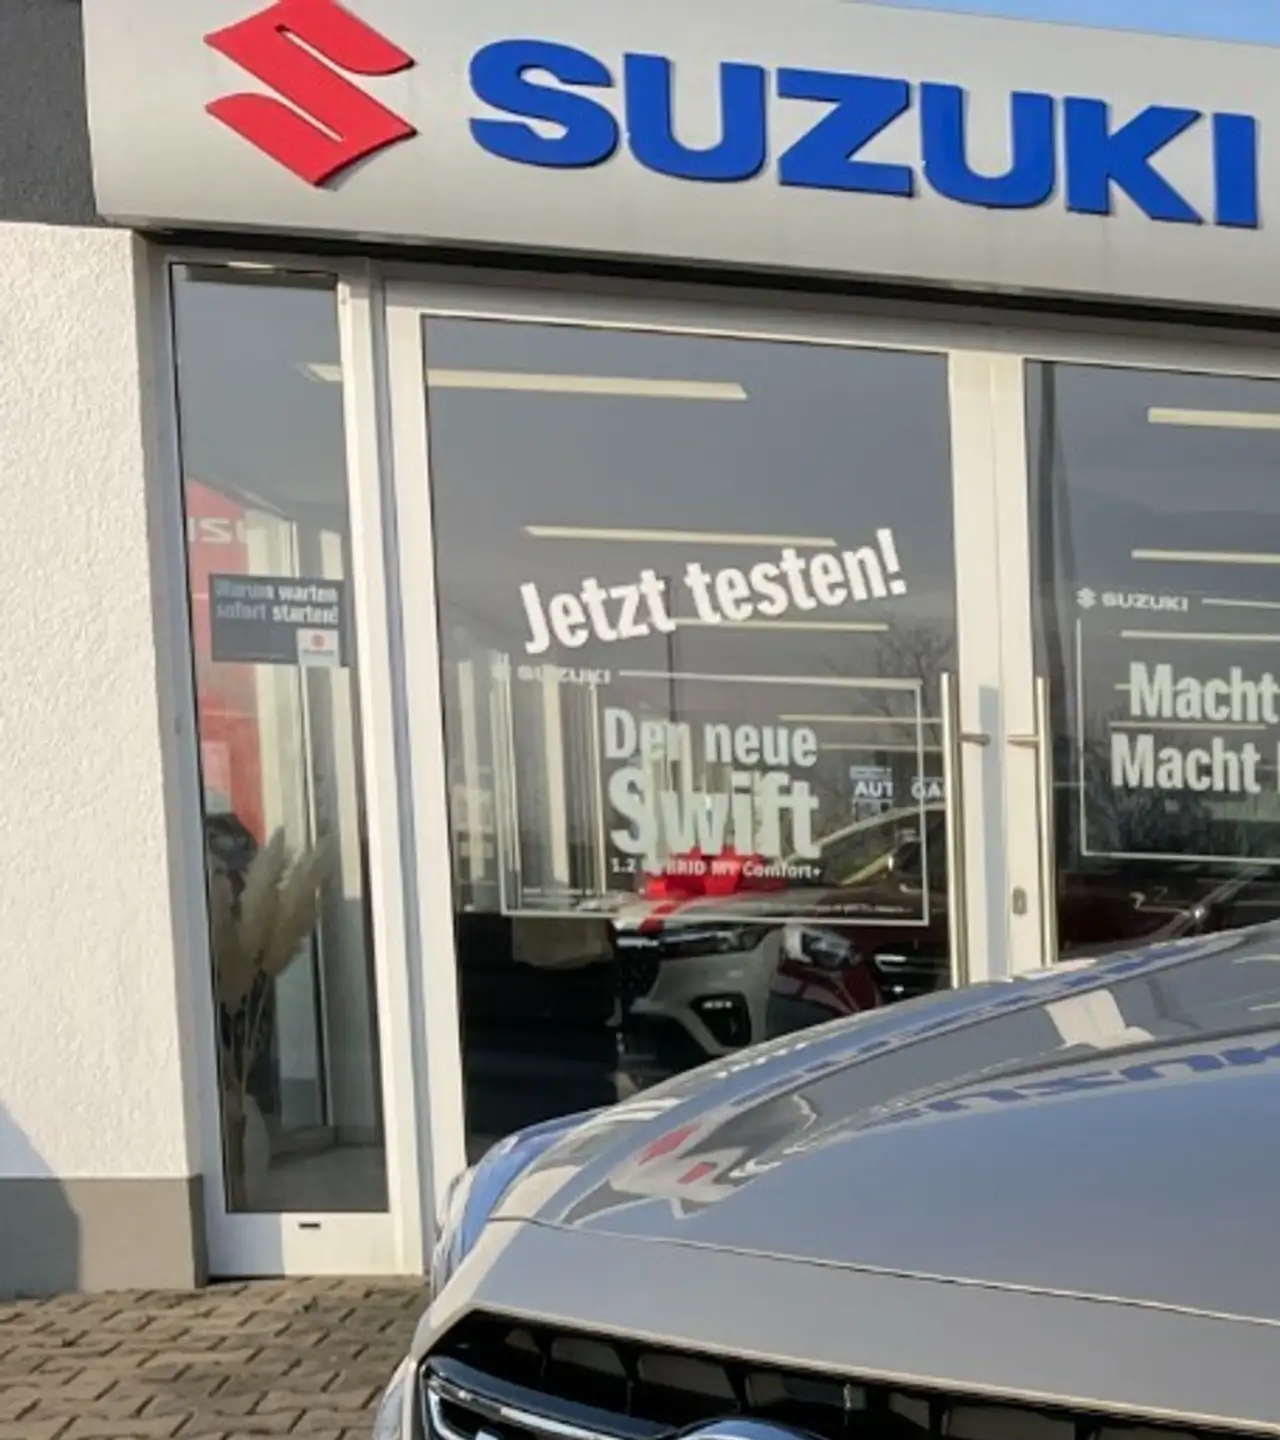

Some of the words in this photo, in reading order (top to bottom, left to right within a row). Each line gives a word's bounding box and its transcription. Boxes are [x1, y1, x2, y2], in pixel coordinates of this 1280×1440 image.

[467, 40, 1257, 228] SUZUKI
[519, 576, 676, 656] Jetzt
[683, 528, 907, 622] testen!
[1101, 590, 1189, 612] SUZUKI
[1129, 662, 1279, 725] Macht
[704, 721, 818, 767] neue
[1110, 733, 1262, 795] Macht
[608, 766, 821, 860] Swift
[611, 857, 637, 873] 1.2
[742, 861, 823, 879] Comfort+
